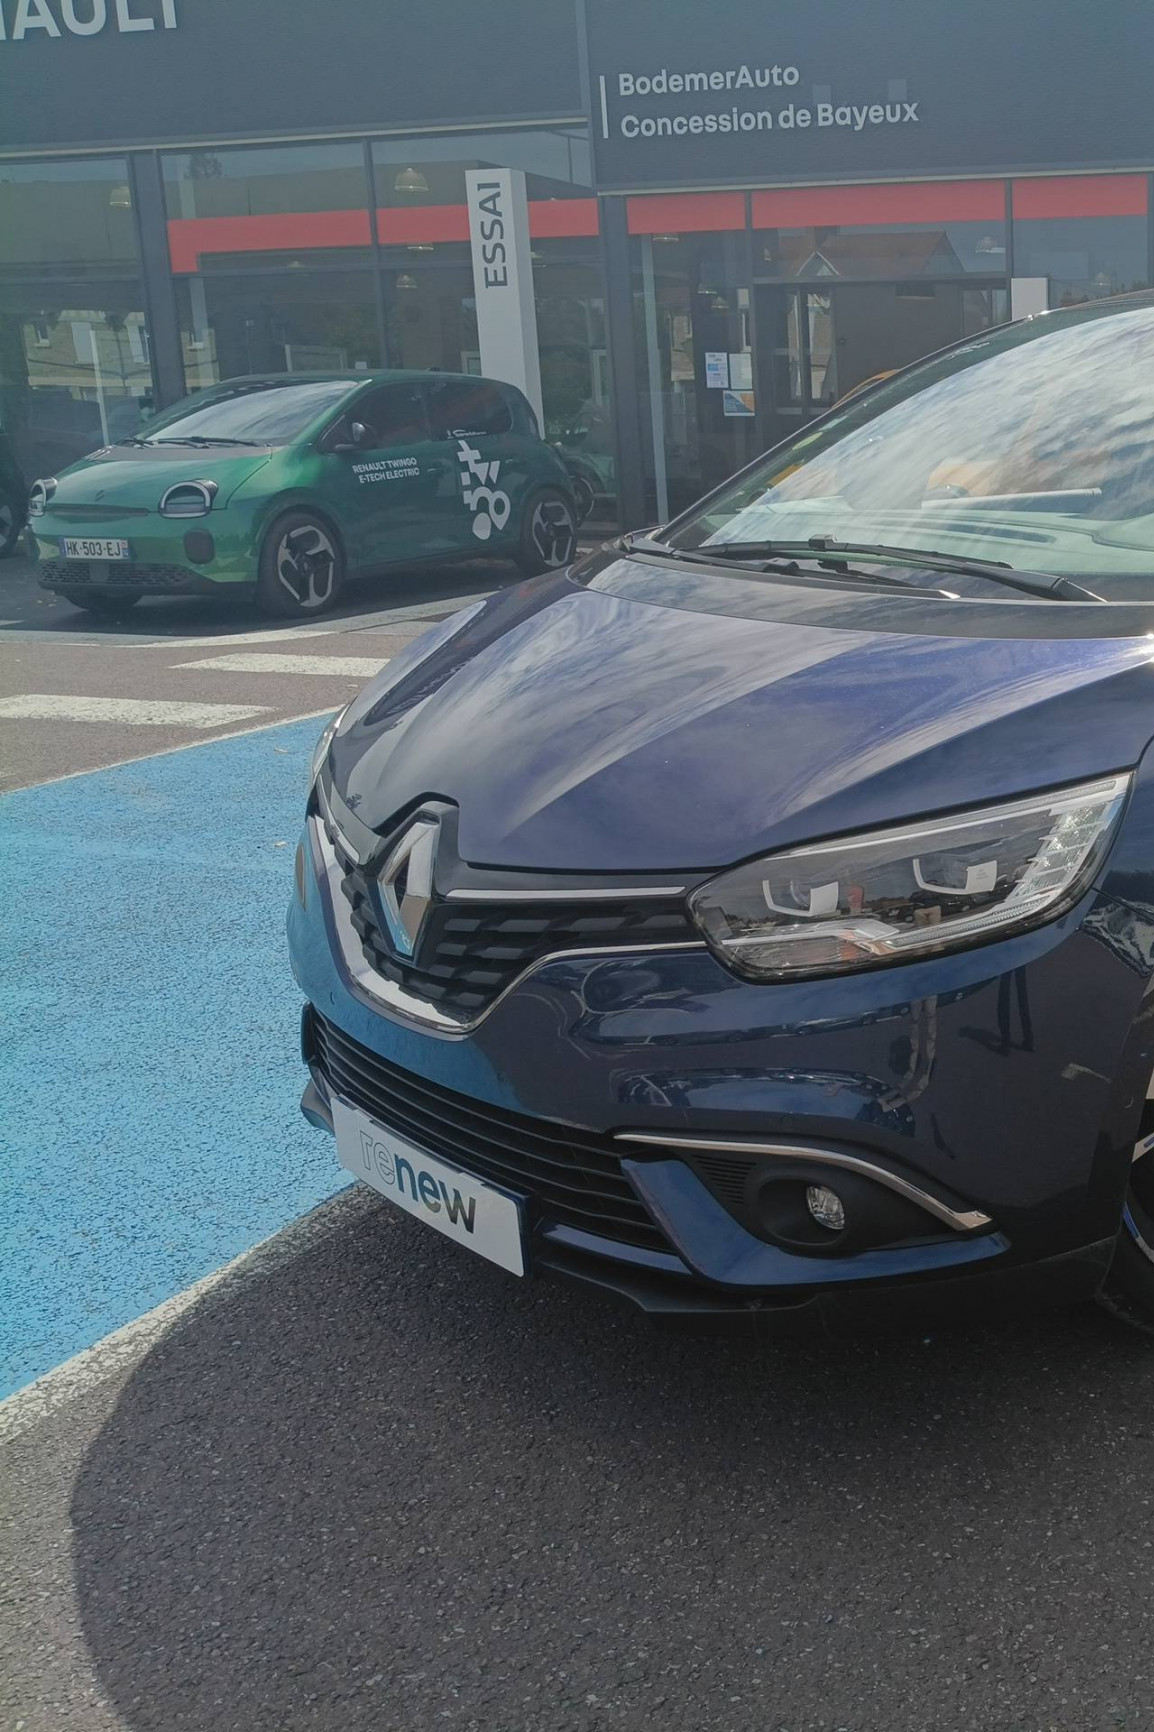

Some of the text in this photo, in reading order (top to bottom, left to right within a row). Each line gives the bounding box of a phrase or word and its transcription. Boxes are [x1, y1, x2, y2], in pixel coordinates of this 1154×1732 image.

[0, 0, 177, 40] AUL
[618, 65, 800, 96] BodemerAuto
[620, 101, 920, 138] Concession de Bayeux
[477, 182, 508, 289] ESSAI
[352, 457, 418, 474] RENAULT TWINGO
[359, 467, 420, 484] E-TECH ELECTRIC
[360, 1130, 477, 1234] renew
